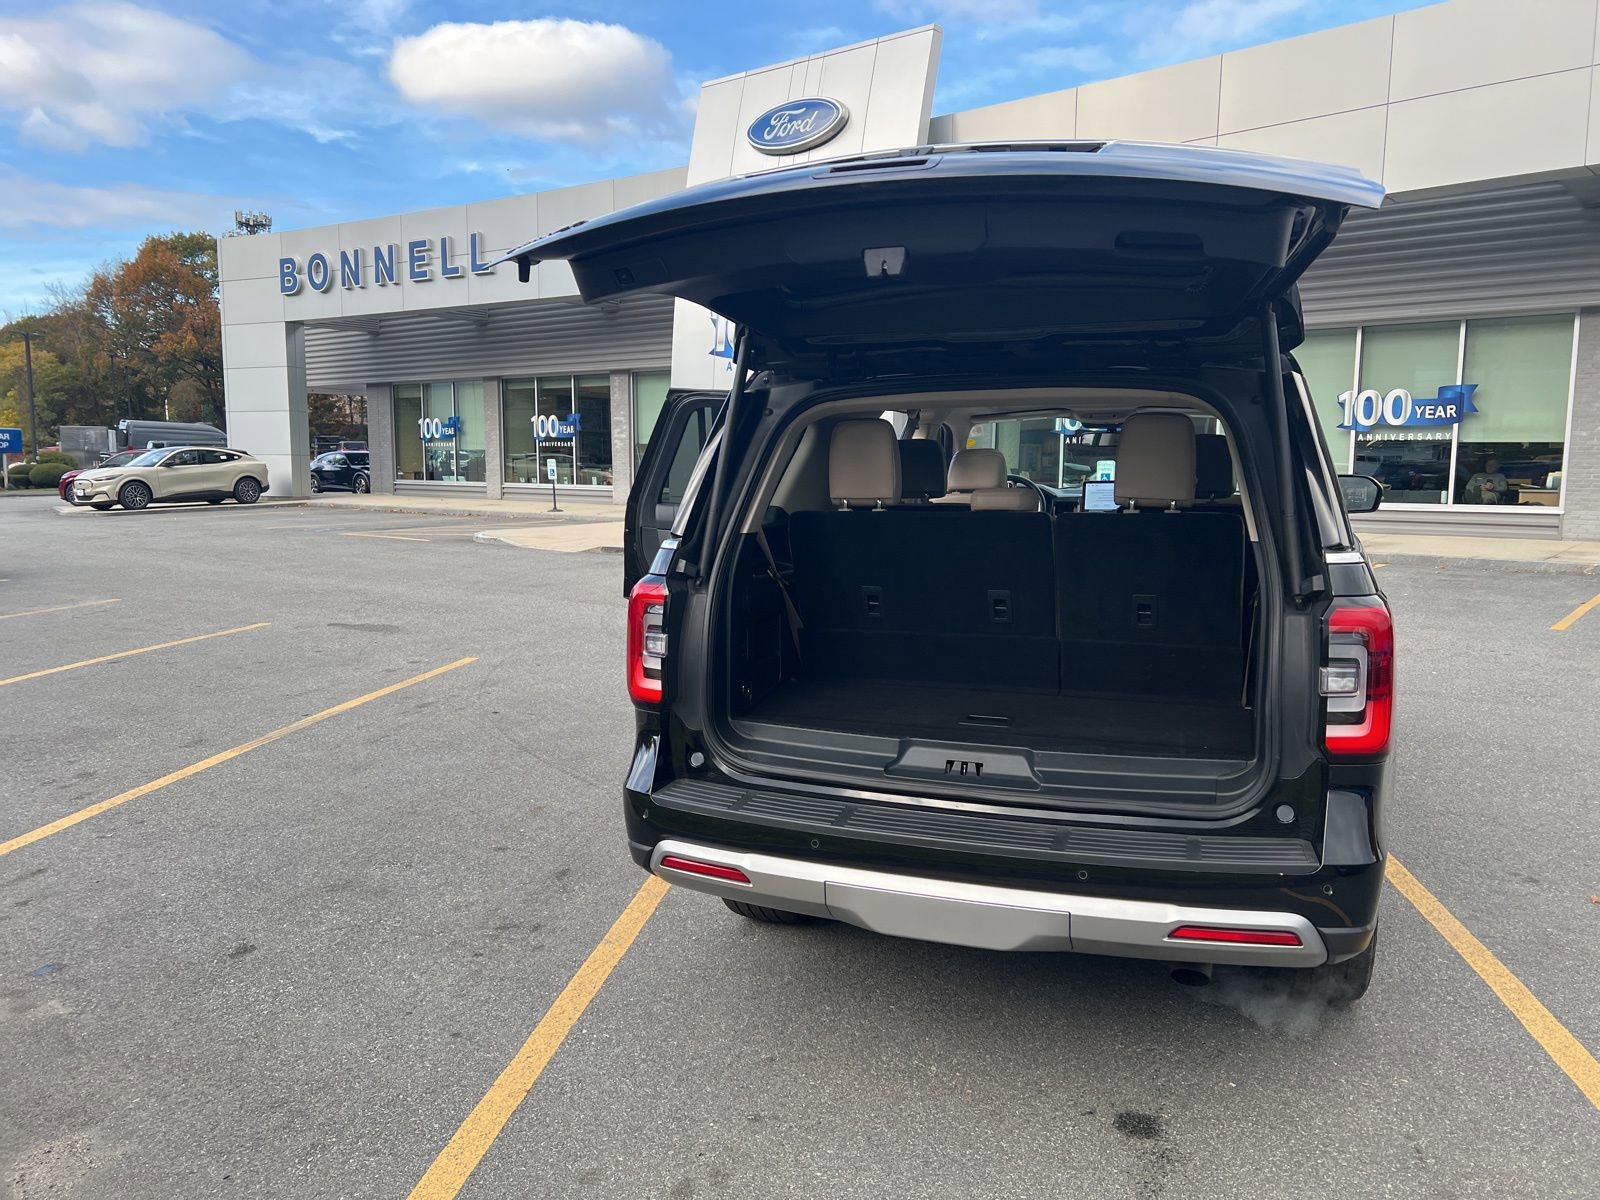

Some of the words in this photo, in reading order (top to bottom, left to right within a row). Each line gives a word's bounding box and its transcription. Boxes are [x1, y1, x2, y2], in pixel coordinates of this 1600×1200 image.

[763, 107, 819, 141] Ford
[279, 231, 492, 295] BONNELL
[1338, 388, 1412, 426] 100
[1415, 404, 1457, 419] YEAR
[417, 417, 441, 439] 100
[530, 414, 559, 437] 100
[559, 425, 575, 434] YEAR
[1357, 432, 1452, 441] ANNIVERSARY
